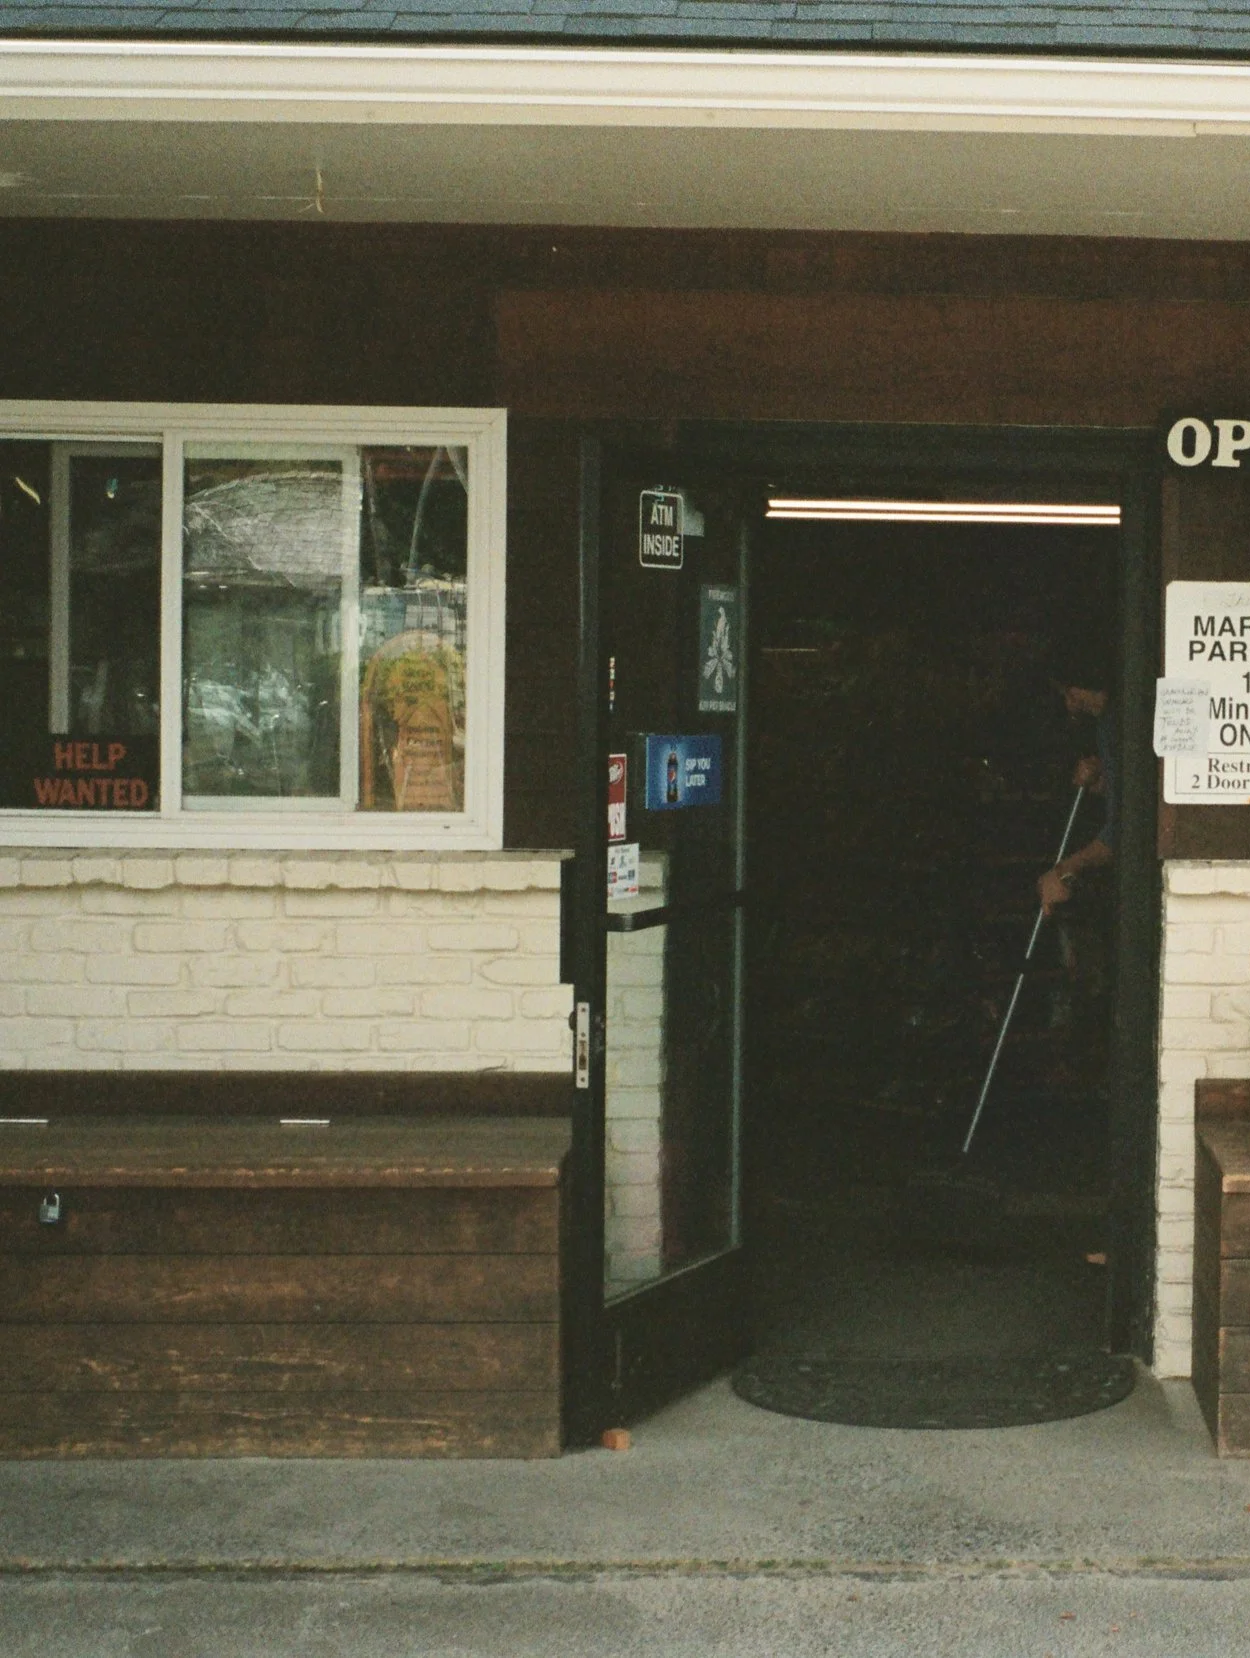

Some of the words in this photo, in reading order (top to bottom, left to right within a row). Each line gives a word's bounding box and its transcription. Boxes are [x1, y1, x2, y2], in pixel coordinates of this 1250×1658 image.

[650, 503, 673, 527] ATM
[643, 534, 680, 557] INSIDE
[53, 742, 127, 770] HELP
[34, 777, 149, 807] WANTED
[1191, 774, 1201, 789] 2
